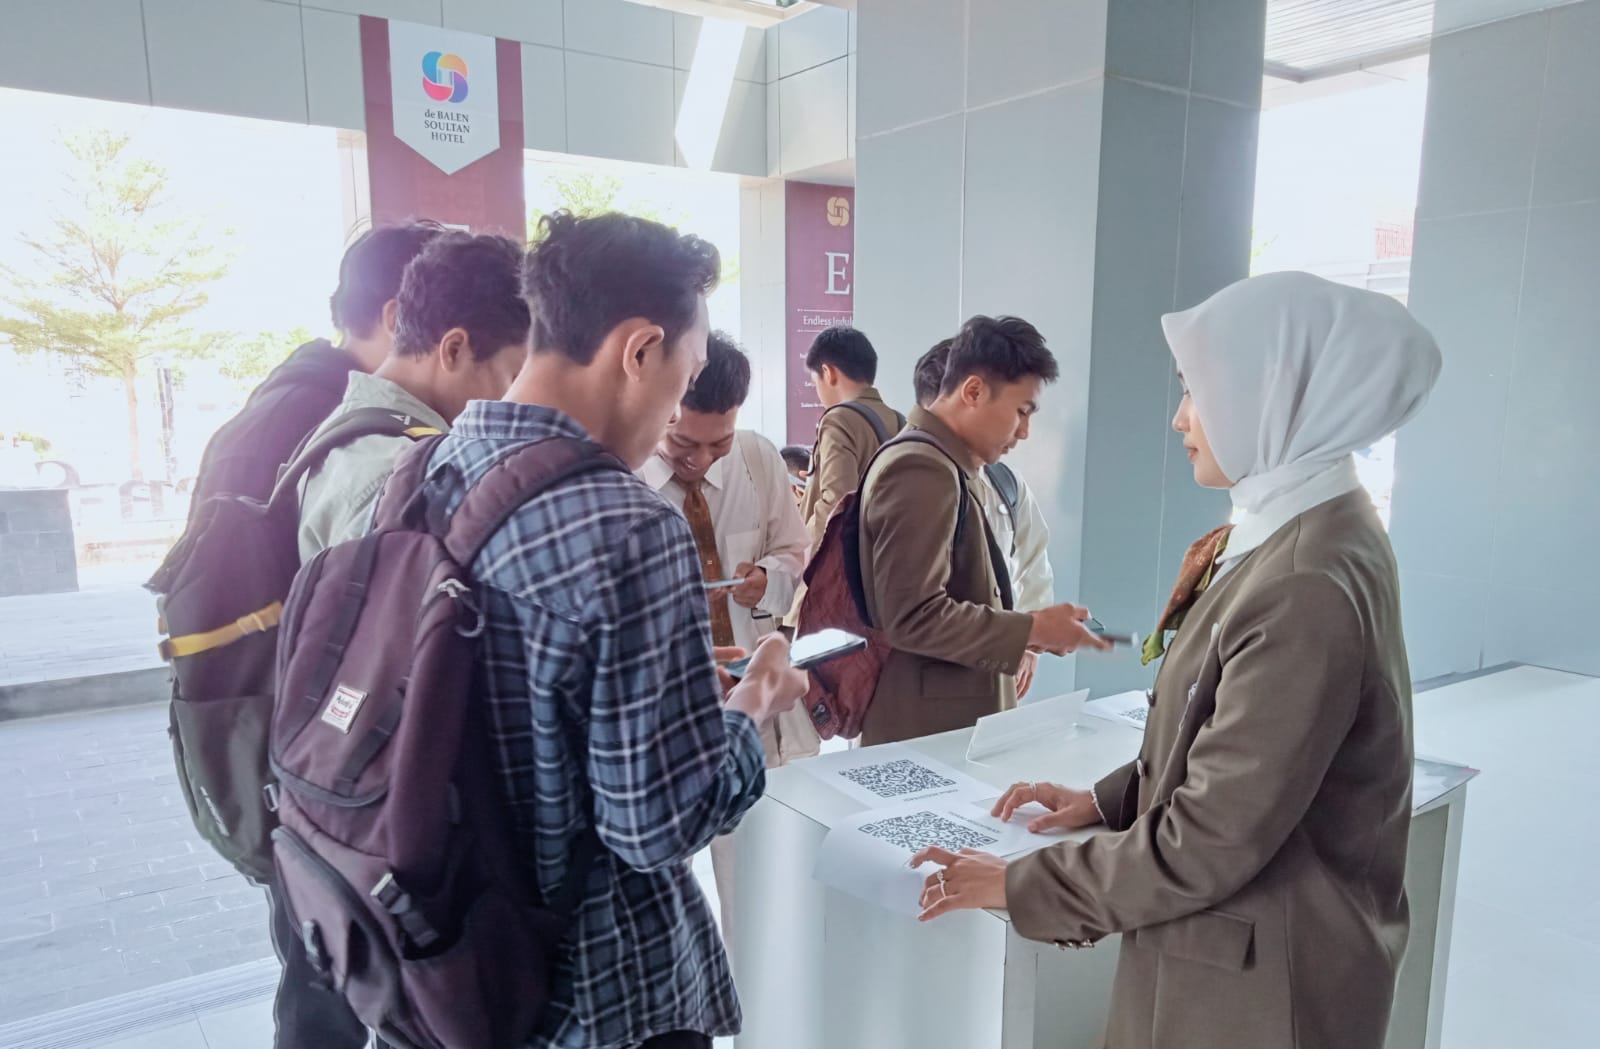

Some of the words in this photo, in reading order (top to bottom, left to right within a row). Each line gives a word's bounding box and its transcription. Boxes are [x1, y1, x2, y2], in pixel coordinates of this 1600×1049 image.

[424, 109, 436, 119] de
[437, 111, 469, 122] BALEN
[424, 120, 470, 133] SOULTAN
[431, 132, 465, 144] HOTEL
[803, 315, 832, 326] Endless
